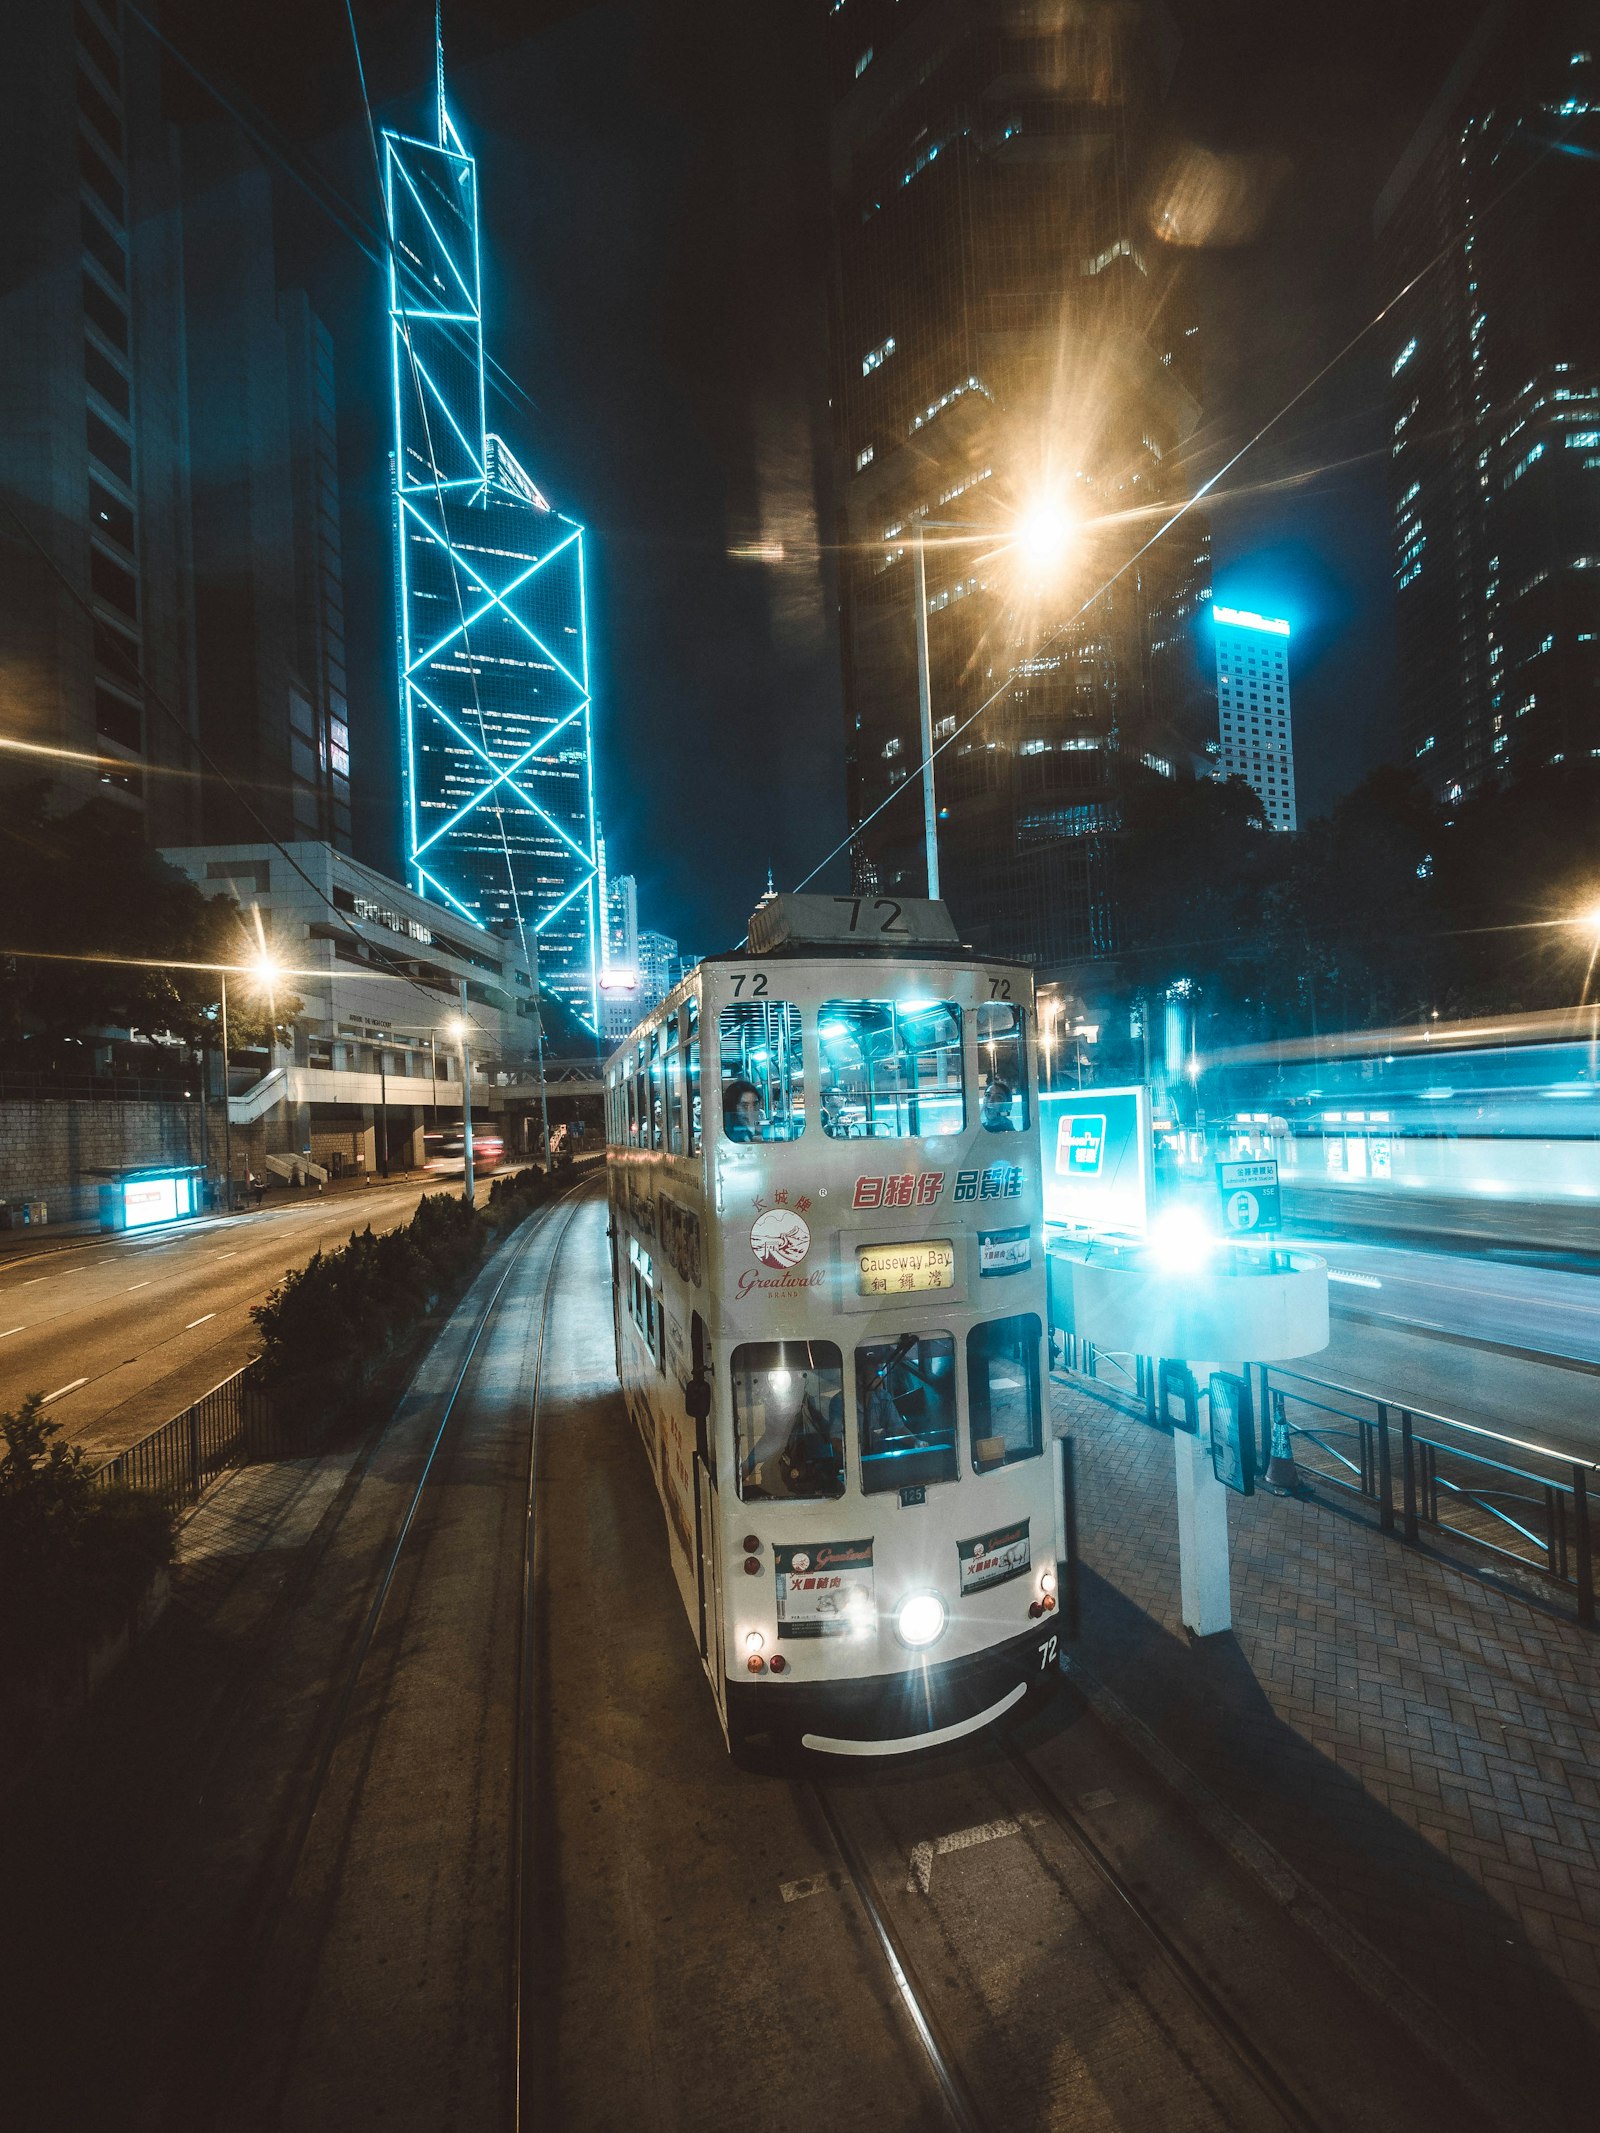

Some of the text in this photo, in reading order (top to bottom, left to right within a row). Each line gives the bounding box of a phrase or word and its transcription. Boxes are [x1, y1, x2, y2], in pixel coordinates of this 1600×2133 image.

[833, 897, 909, 933] 72
[730, 973, 768, 997] 72
[988, 978, 1011, 999] 72
[852, 1167, 1024, 1209] 白豬仔 品質佳
[860, 1250, 951, 1273] Causeway Bay
[735, 1269, 826, 1300] Greatwall
[871, 1269, 942, 1292] 銅鑼灣
[768, 1291, 798, 1299] BRAND
[903, 1488, 922, 1502] 125
[1038, 1635, 1058, 1670] 72
